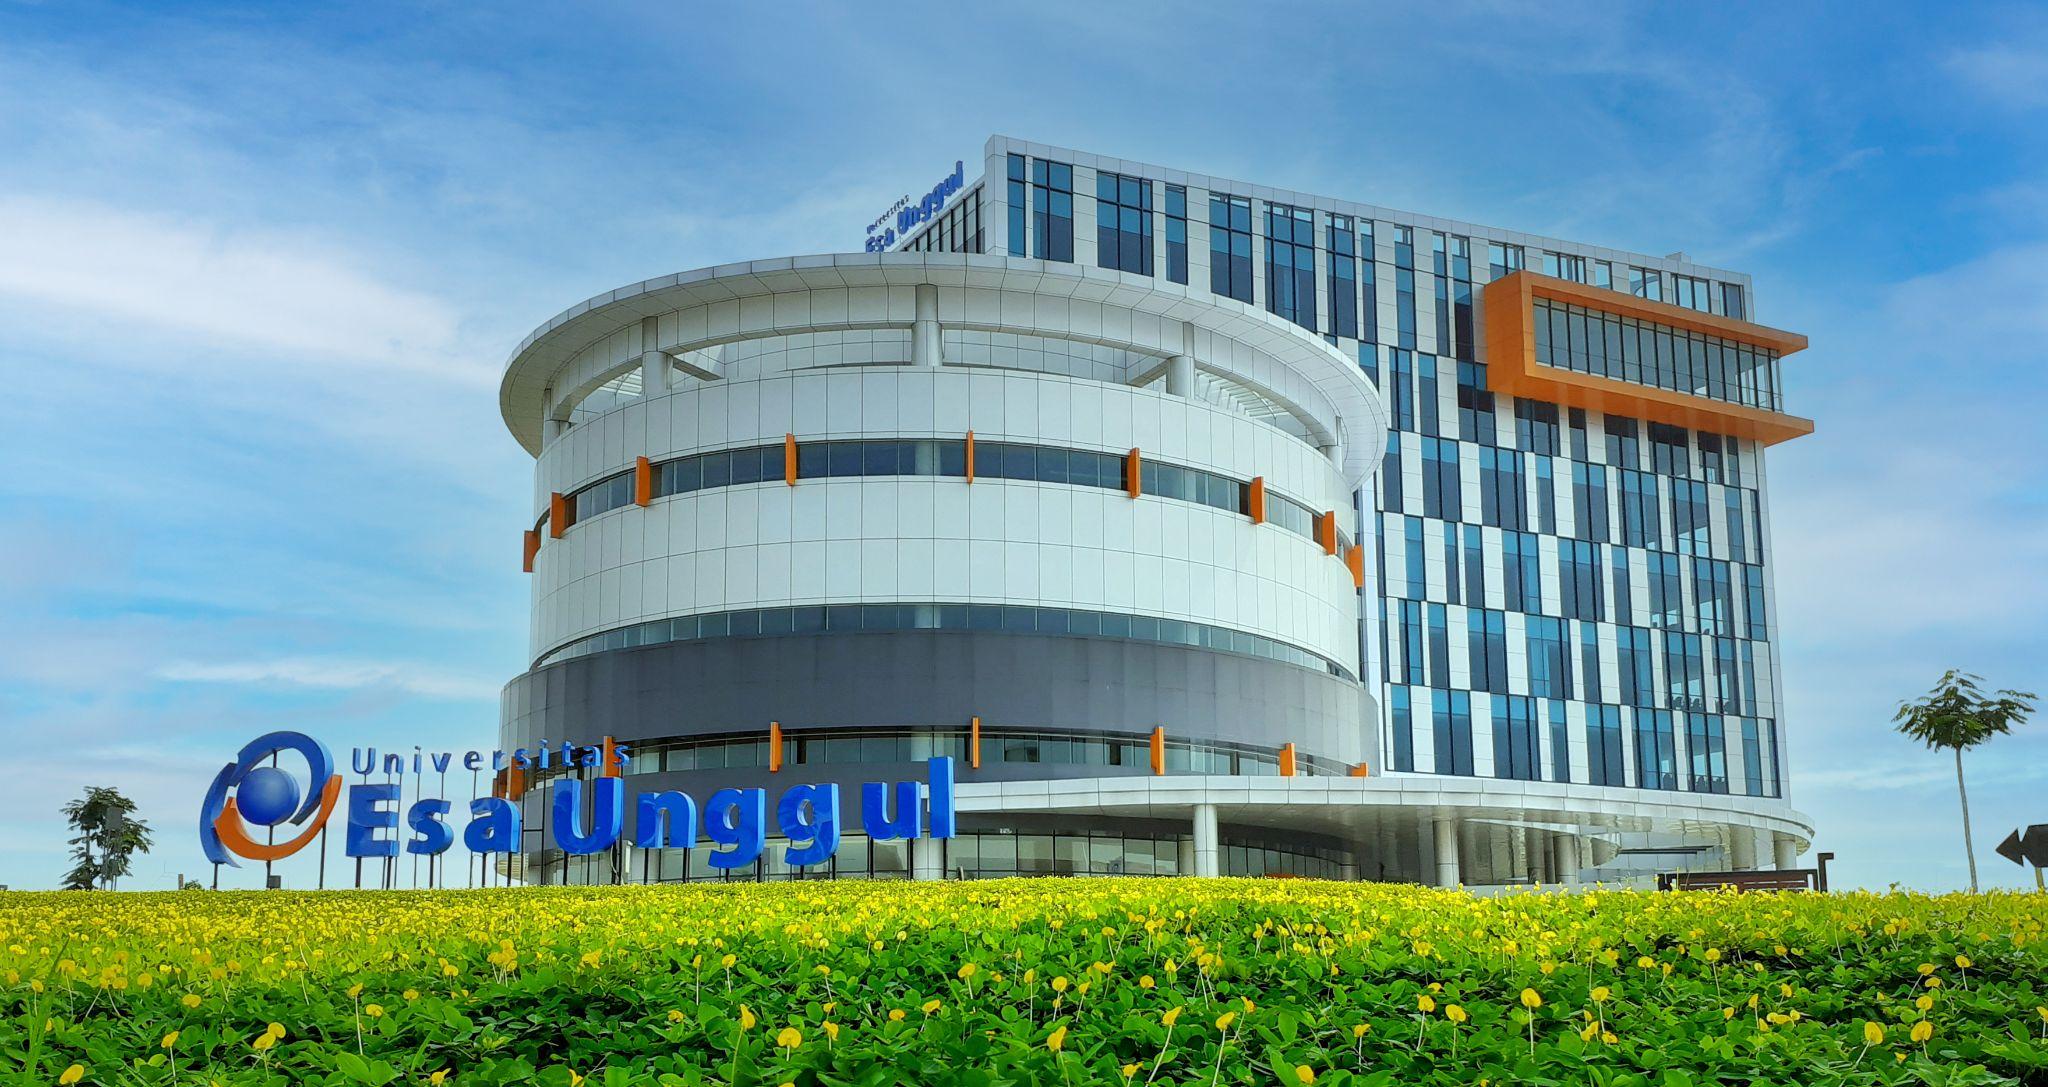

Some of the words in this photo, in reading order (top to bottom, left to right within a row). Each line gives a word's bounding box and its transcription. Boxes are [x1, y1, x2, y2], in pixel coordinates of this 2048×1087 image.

[897, 160, 964, 235] Unggul
[352, 737, 631, 775] Universitas
[345, 783, 521, 858] Esa
[552, 756, 955, 868] Unggul
